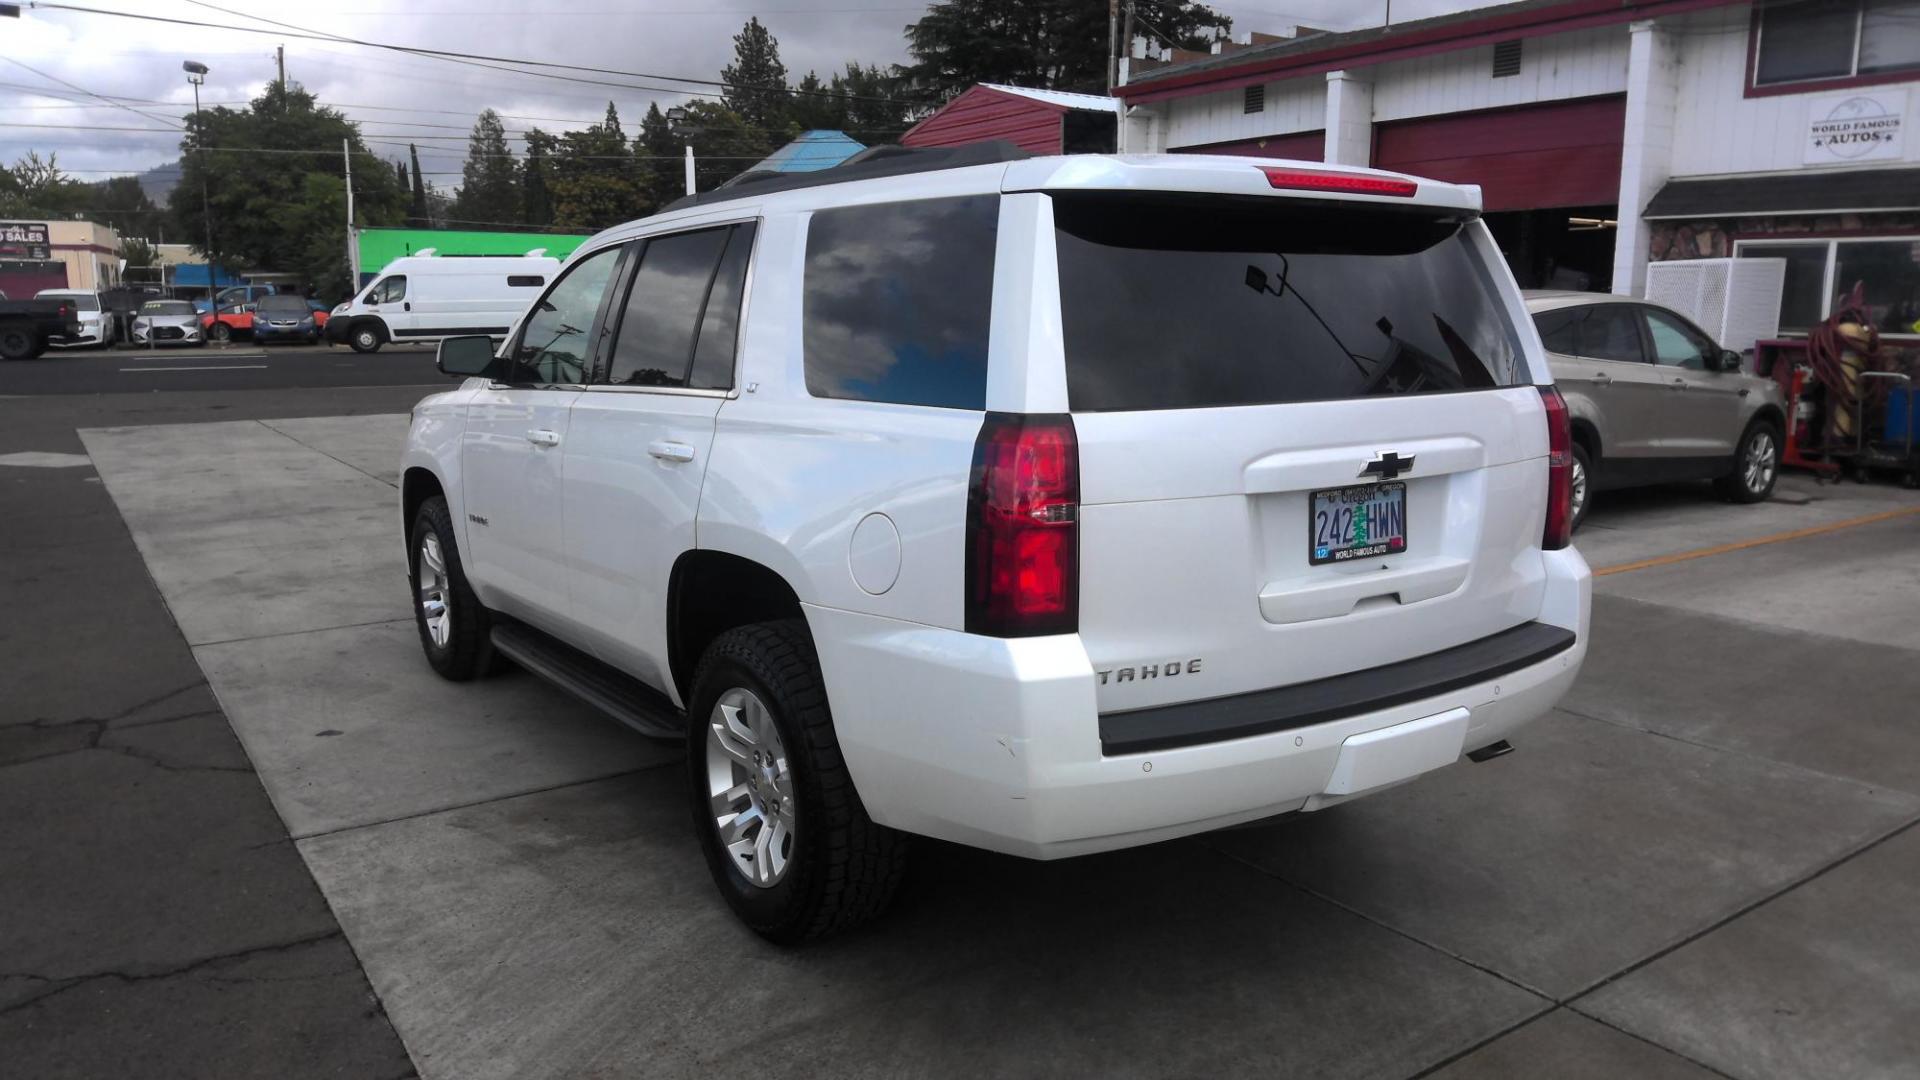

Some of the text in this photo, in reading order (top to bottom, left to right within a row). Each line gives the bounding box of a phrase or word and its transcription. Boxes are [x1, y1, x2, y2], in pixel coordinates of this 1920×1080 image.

[1812, 119, 1900, 133] WORLD FAMOUS
[1829, 132, 1881, 145] AUTOS
[6, 232, 43, 242] SALES
[1317, 501, 1401, 547] 242 HWN
[1335, 545, 1387, 560] WORLD FAMOUS AUTO
[1097, 658, 1202, 685] TAHOE
